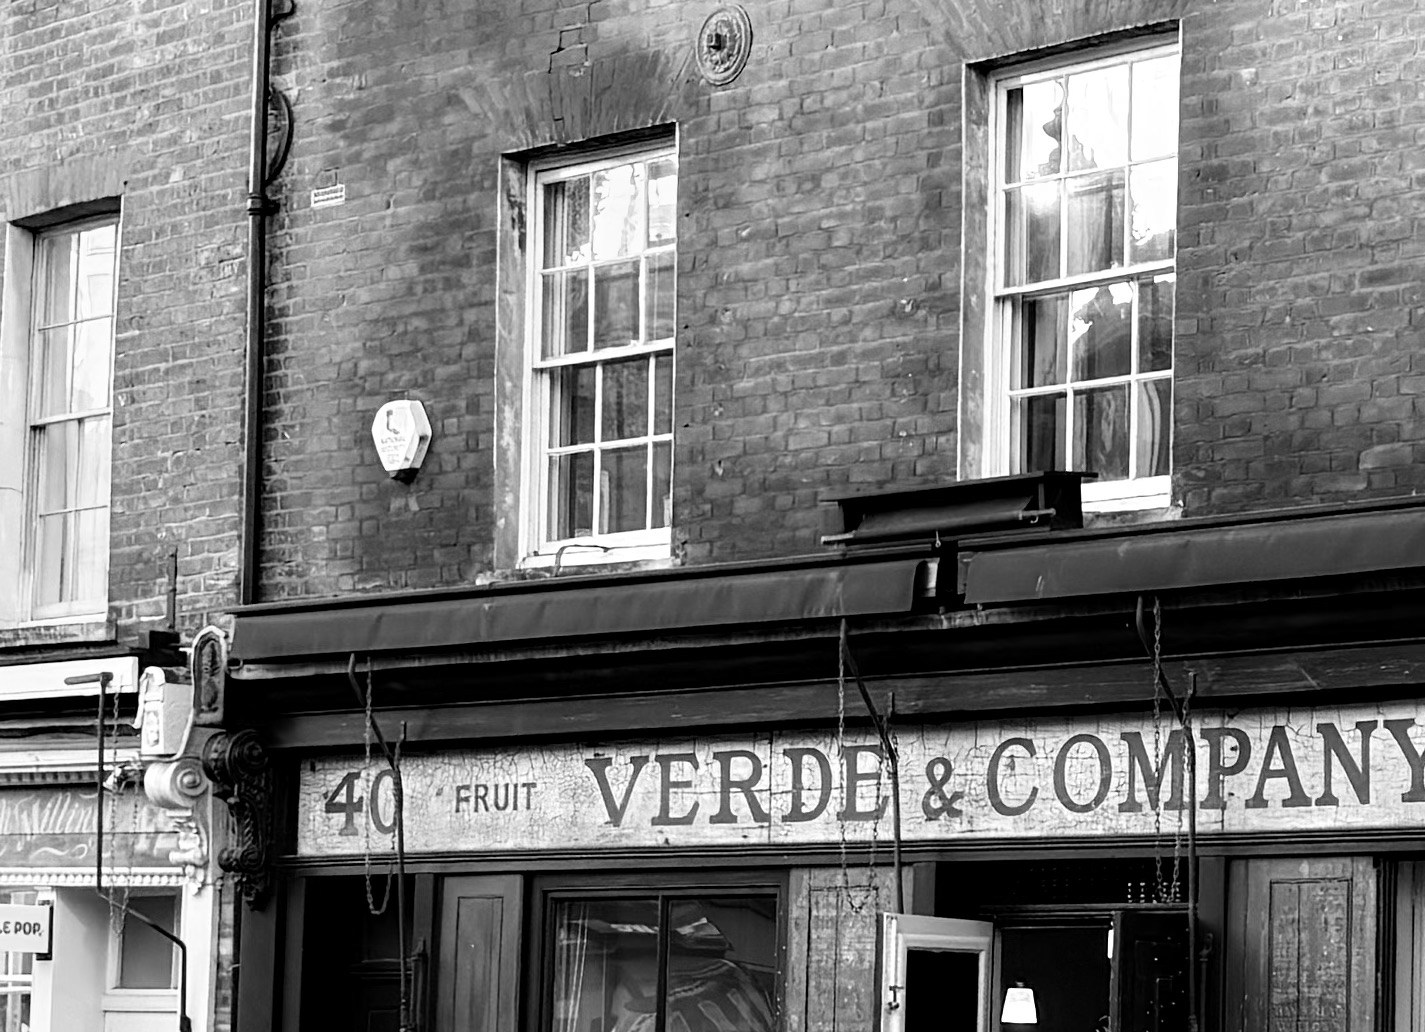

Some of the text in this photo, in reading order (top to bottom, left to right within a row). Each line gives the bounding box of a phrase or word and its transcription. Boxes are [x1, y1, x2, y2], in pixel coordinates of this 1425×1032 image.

[323, 770, 399, 837] 40
[454, 782, 538, 815] FRUIT
[585, 745, 892, 828] VERDE
[920, 756, 965, 821] &
